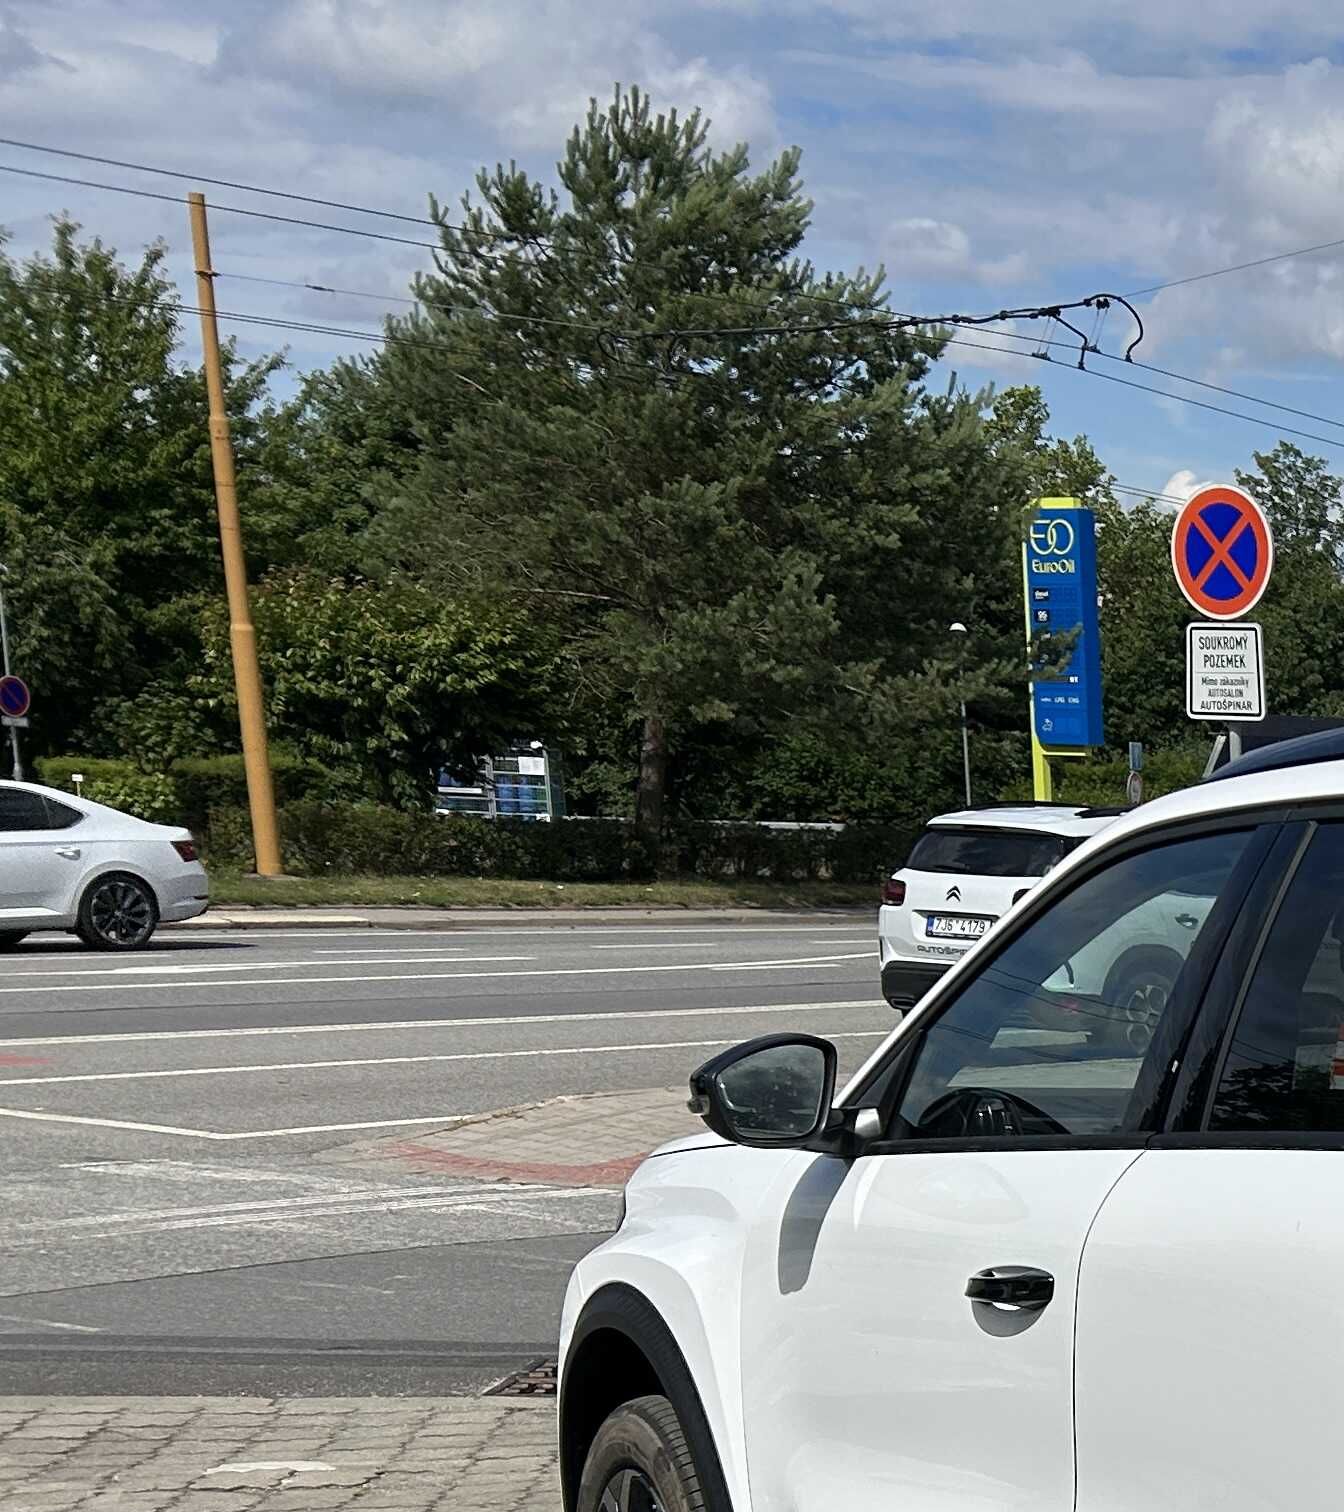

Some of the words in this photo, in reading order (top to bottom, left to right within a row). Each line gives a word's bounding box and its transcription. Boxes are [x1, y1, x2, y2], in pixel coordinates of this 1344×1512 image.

[1031, 559, 1076, 574] EuroOil
[1203, 653, 1247, 669] POZEMEK
[1207, 688, 1244, 697] AUTOSALON
[1199, 699, 1253, 711] AUTOŠPINAR
[960, 919, 986, 934] 4179
